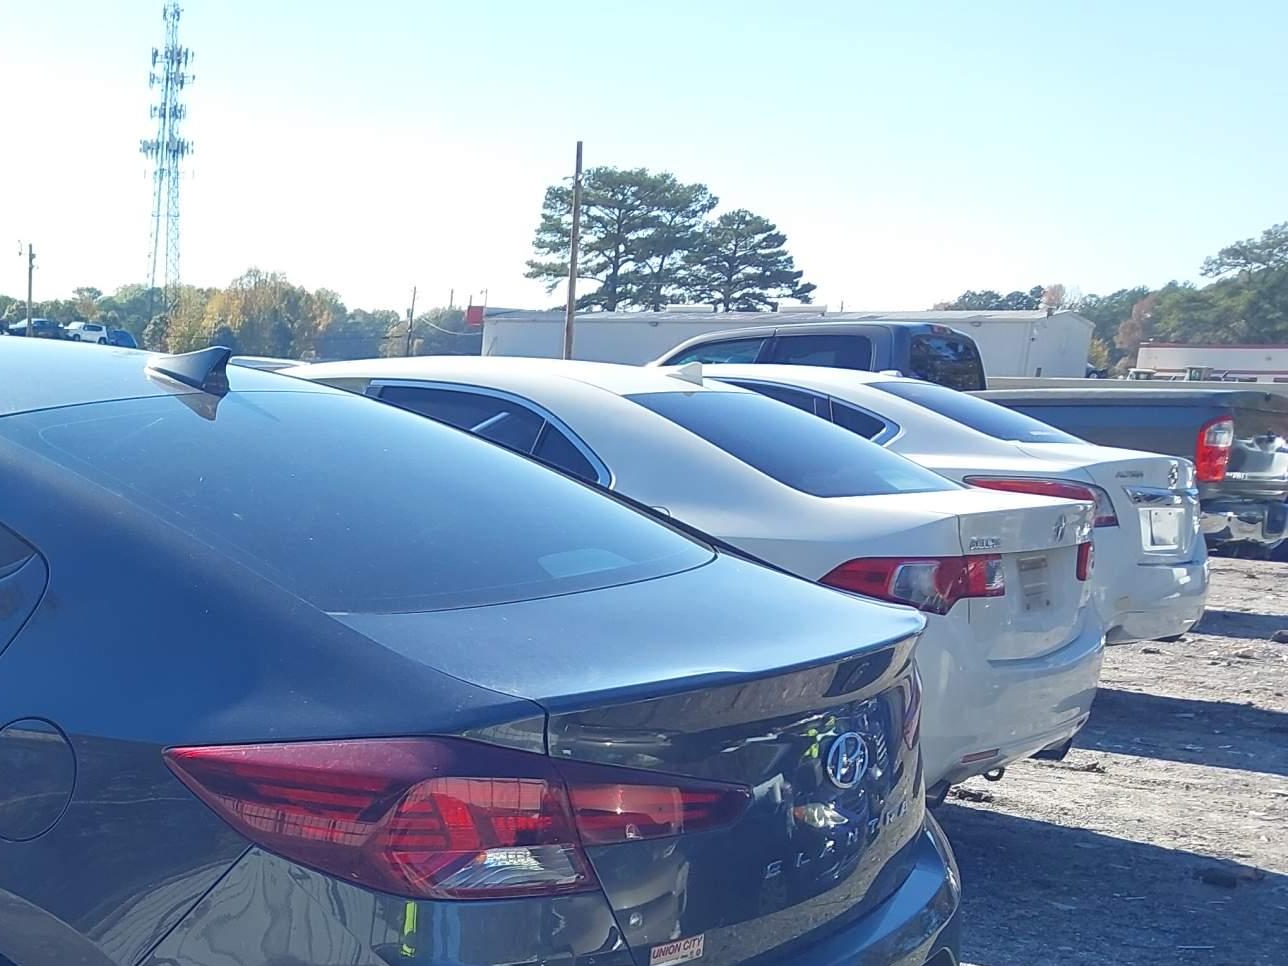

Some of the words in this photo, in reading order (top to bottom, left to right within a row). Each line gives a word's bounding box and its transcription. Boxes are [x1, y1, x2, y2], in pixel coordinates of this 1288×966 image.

[764, 800, 908, 880] ELANTRA
[652, 942, 682, 960] UNION
[683, 935, 703, 951] CITY
